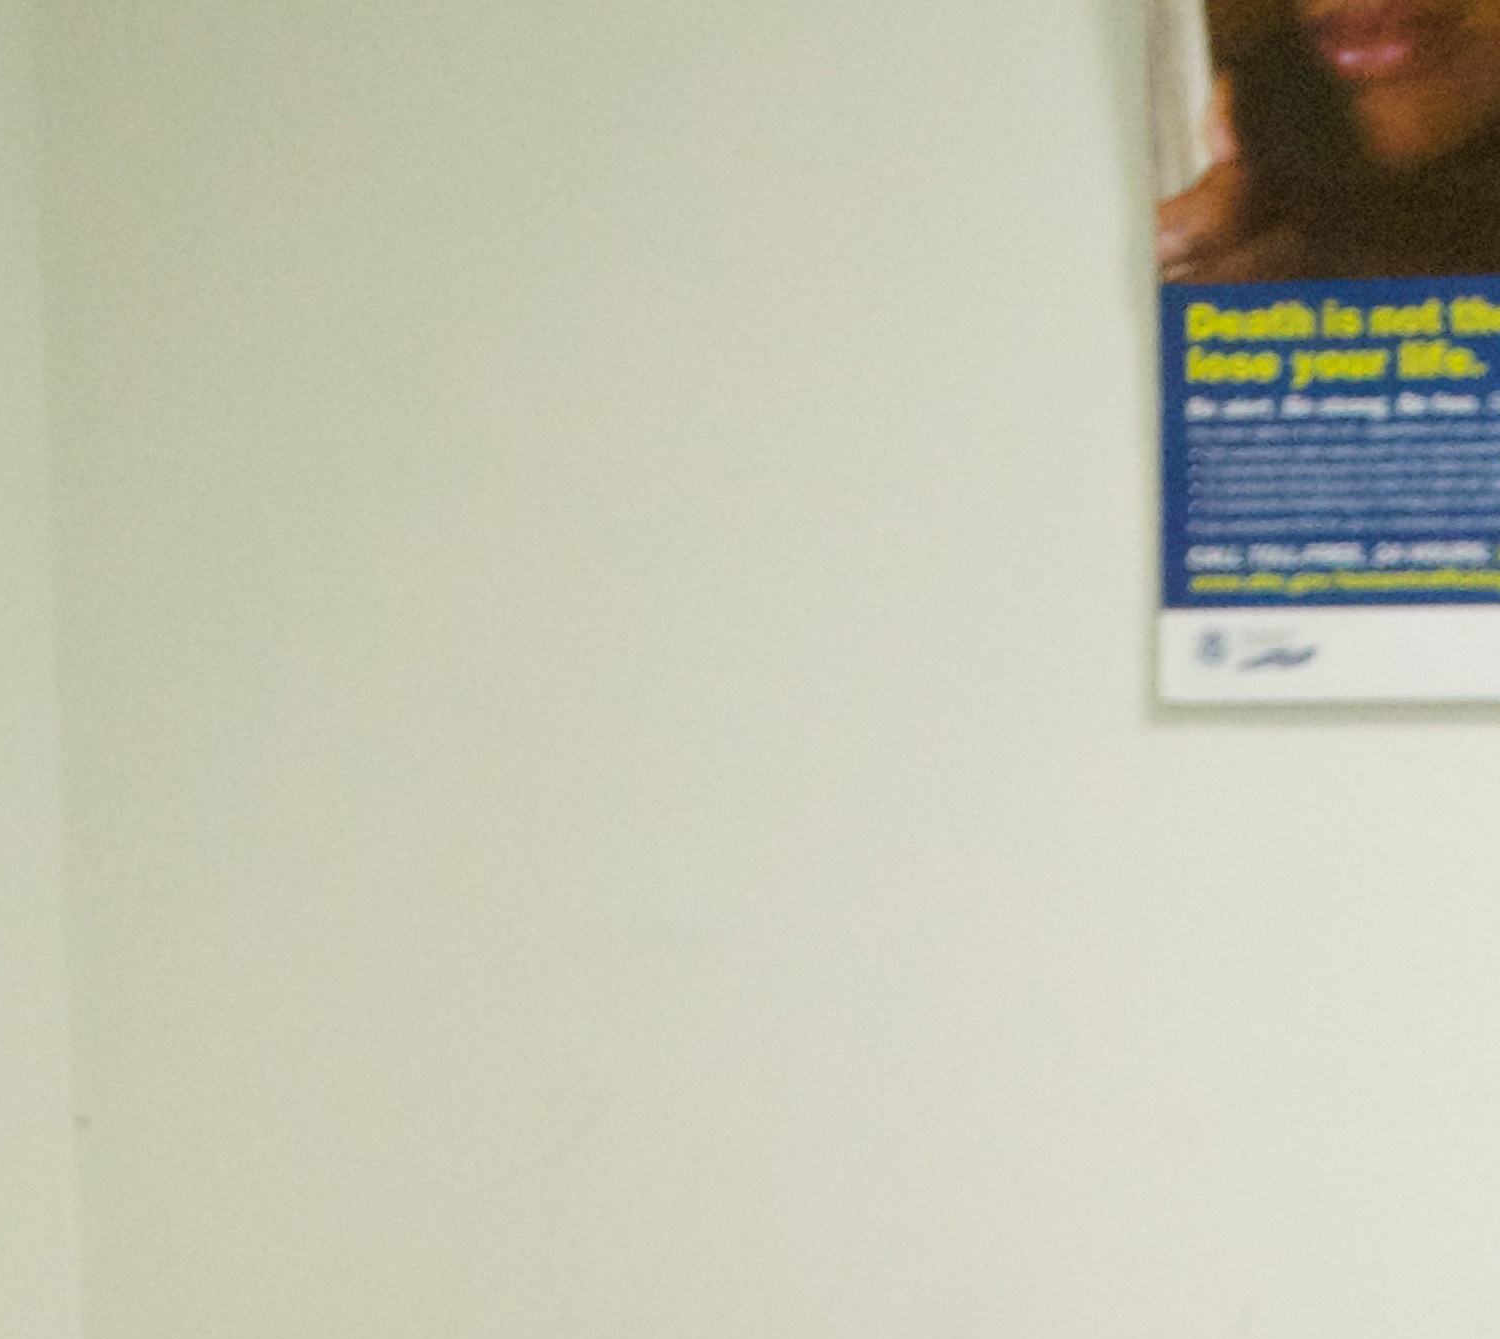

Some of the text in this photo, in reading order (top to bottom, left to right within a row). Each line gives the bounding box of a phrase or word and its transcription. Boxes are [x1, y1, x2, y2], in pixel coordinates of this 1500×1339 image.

[1186, 302, 1315, 341] Death
[1322, 299, 1363, 338] is
[1369, 297, 1442, 336] not
[1185, 345, 1281, 383] lose
[1290, 350, 1389, 390] your
